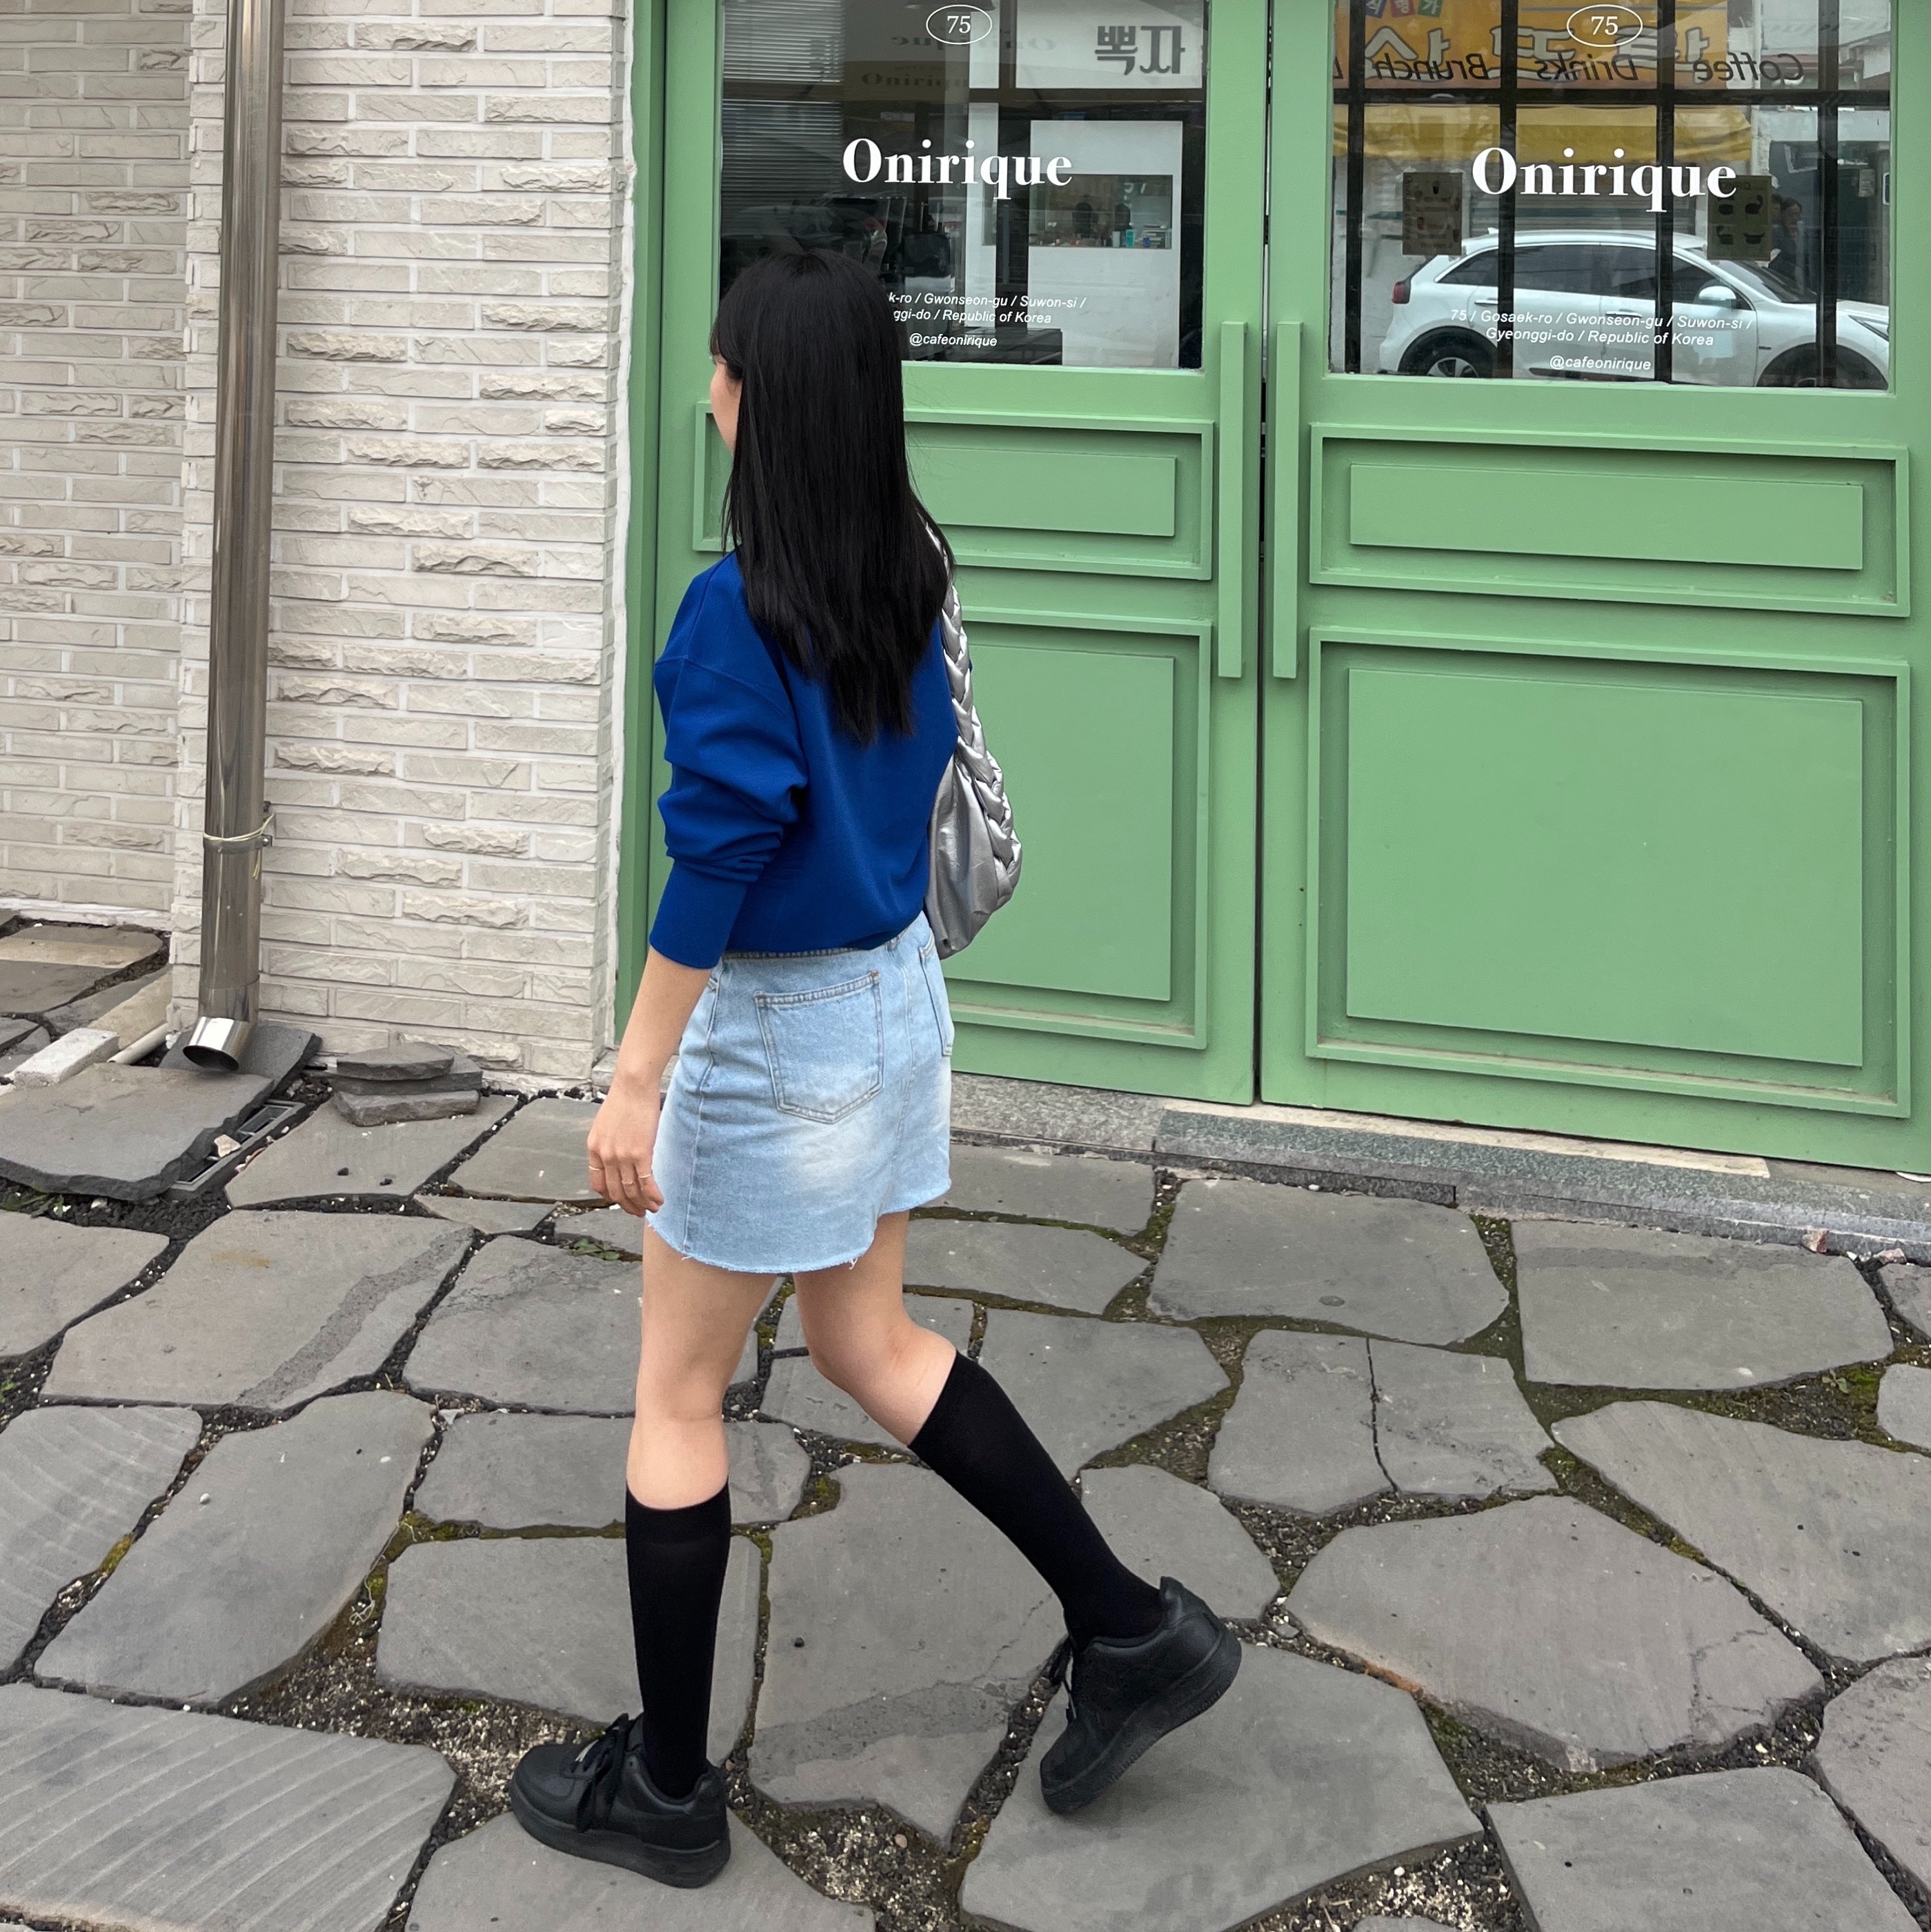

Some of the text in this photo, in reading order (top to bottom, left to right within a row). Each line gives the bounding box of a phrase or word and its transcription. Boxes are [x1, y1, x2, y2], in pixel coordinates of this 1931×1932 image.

[947, 15, 971, 34] 75
[1591, 16, 1618, 35] 75
[842, 138, 1073, 200] Onirique
[1472, 146, 1737, 212] Onirique
[889, 292, 912, 304] k-ro
[924, 292, 1008, 308] Gwonseon-gu
[1020, 295, 1078, 308] Suwon-si
[893, 309, 931, 322] ggi-do
[942, 309, 996, 323] Republic
[1000, 311, 1012, 323] of
[1014, 311, 1052, 323] Korea
[1450, 310, 1467, 321] 75
[1481, 310, 1552, 324] Gosaek-ro
[1566, 312, 1663, 329] Gwonseon-gu
[1677, 316, 1743, 330] Suwon-si
[909, 332, 998, 348] @cafeonirique
[1485, 327, 1574, 344] Gyeonggi-do
[1587, 331, 1650, 346] Republic
[1654, 332, 1668, 344] of
[1672, 332, 1714, 346] Korea
[1549, 355, 1652, 371] @cafeonirique
